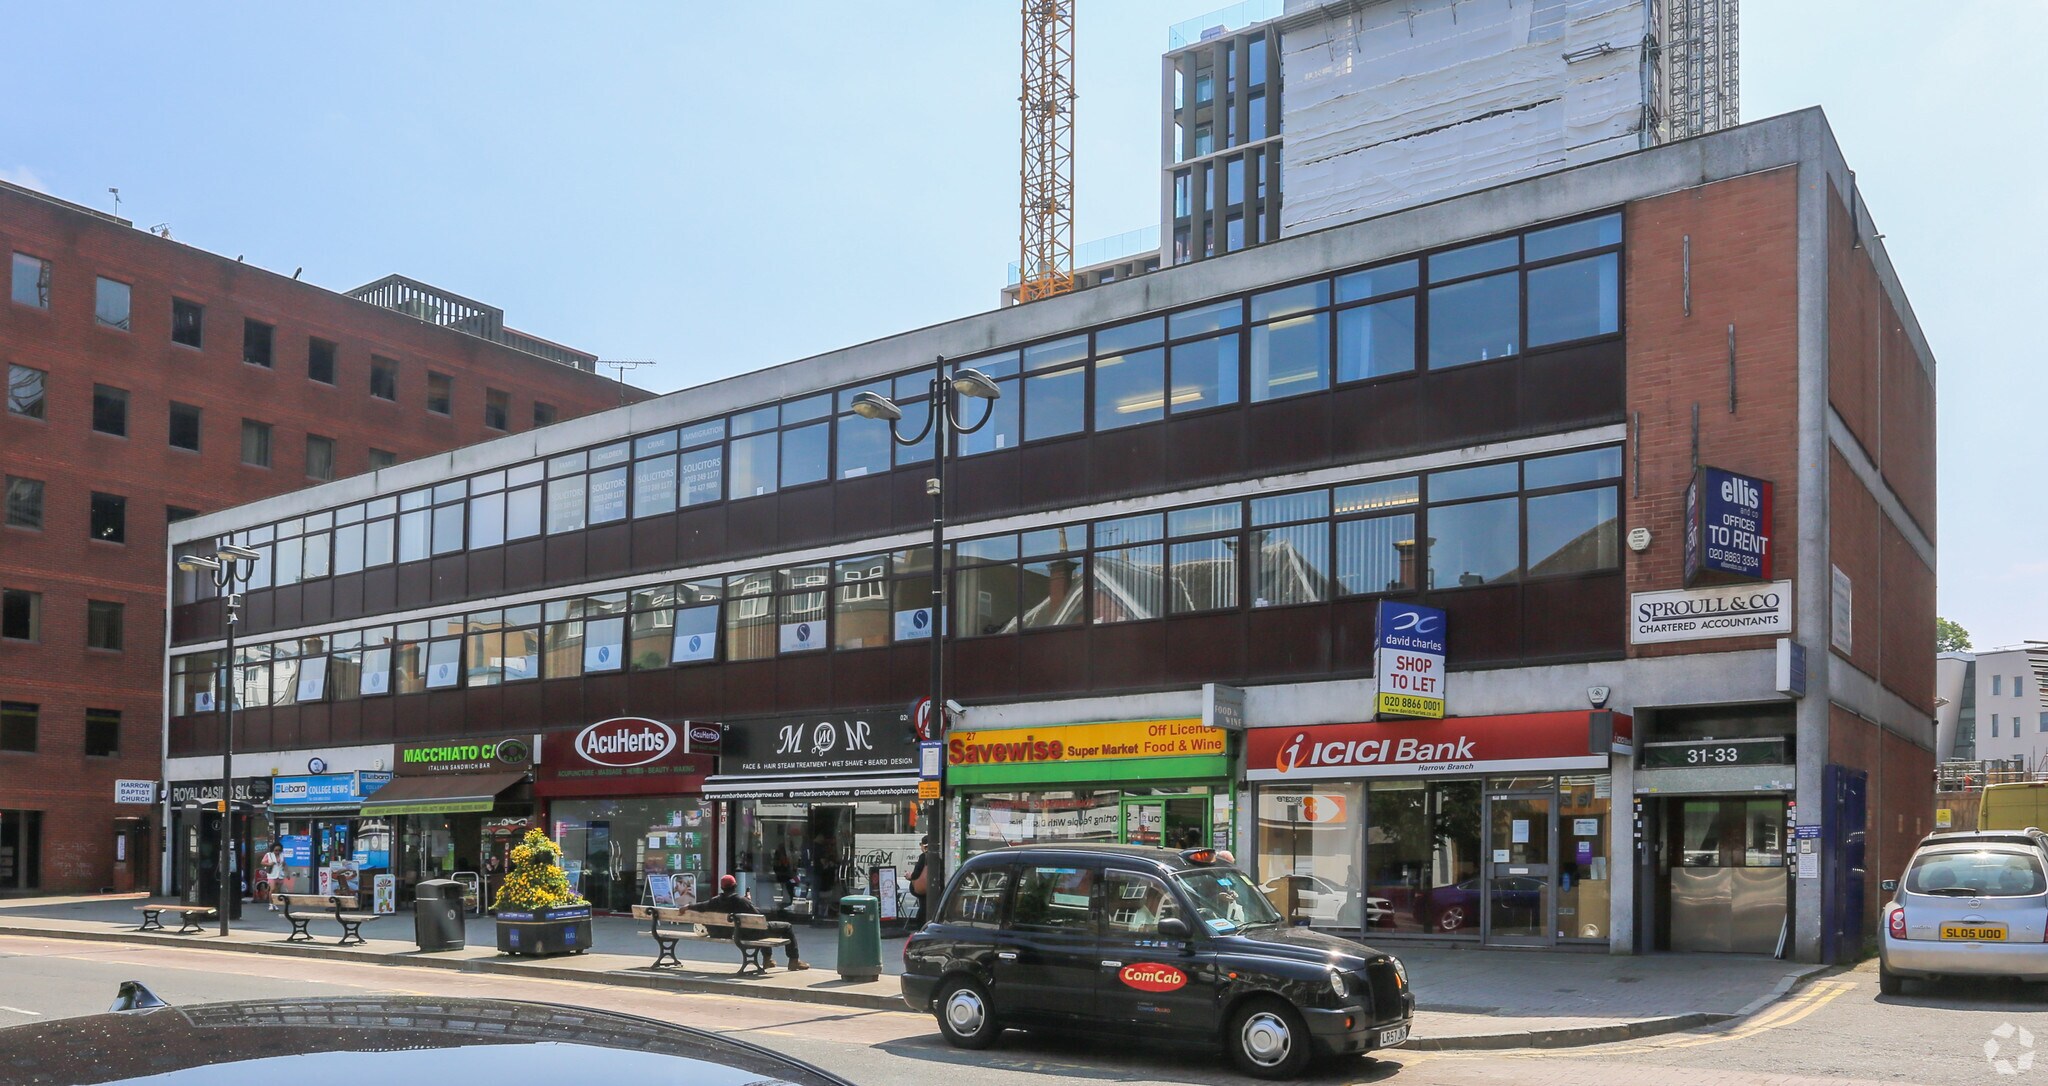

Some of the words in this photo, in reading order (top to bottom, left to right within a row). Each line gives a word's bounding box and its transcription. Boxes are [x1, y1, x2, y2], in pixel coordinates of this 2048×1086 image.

[648, 439, 665, 450] CRIME
[598, 449, 622, 460] CHILDREN
[683, 457, 720, 474] SOLICITORS
[638, 468, 674, 483] SOLICITORS
[592, 478, 626, 493] SOLICITORS
[1721, 477, 1758, 509] ellis
[1740, 507, 1750, 516] and
[1723, 514, 1755, 532] OFFICES
[1709, 525, 1729, 546] TO
[1733, 530, 1768, 555] RENT
[1709, 548, 1723, 559] 020
[1725, 551, 1740, 563] 8863
[1742, 554, 1758, 567] 3334
[1639, 622, 1696, 634] CHARTERED
[1701, 615, 1778, 629] ACCOUNTANTS
[1386, 635, 1410, 646] david
[1412, 638, 1441, 651] charles
[1396, 655, 1432, 673] SHOP
[1391, 673, 1408, 689] TO
[1413, 676, 1436, 693] LET
[1215, 705, 1232, 715] FOOD
[1385, 696, 1400, 706] 020
[1402, 698, 1421, 709] 8866
[1423, 700, 1440, 711] 0001
[693, 731, 717, 739] AcuHerbs
[967, 732, 976, 740] 27
[1149, 724, 1167, 736] Off
[1170, 722, 1217, 735] Licence
[587, 728, 665, 754] AcuHerbs
[1144, 741, 1176, 753] Food
[1178, 741, 1187, 751] &
[1191, 739, 1222, 750] Wine
[404, 746, 479, 763] MACCHIATO
[949, 736, 1064, 764] Savewise
[1067, 745, 1099, 758] Super
[1102, 743, 1139, 755] Market
[1310, 740, 1390, 764] ICICI
[1394, 736, 1476, 762] Bank
[1687, 748, 1738, 763] 31-33
[173, 788, 198, 802] ROYAL
[281, 785, 306, 793] Lebara
[308, 786, 331, 794] COLLEGE
[332, 785, 348, 794] NEWS
[1946, 928, 1975, 938] SL05
[1124, 968, 1181, 984] ComCab
